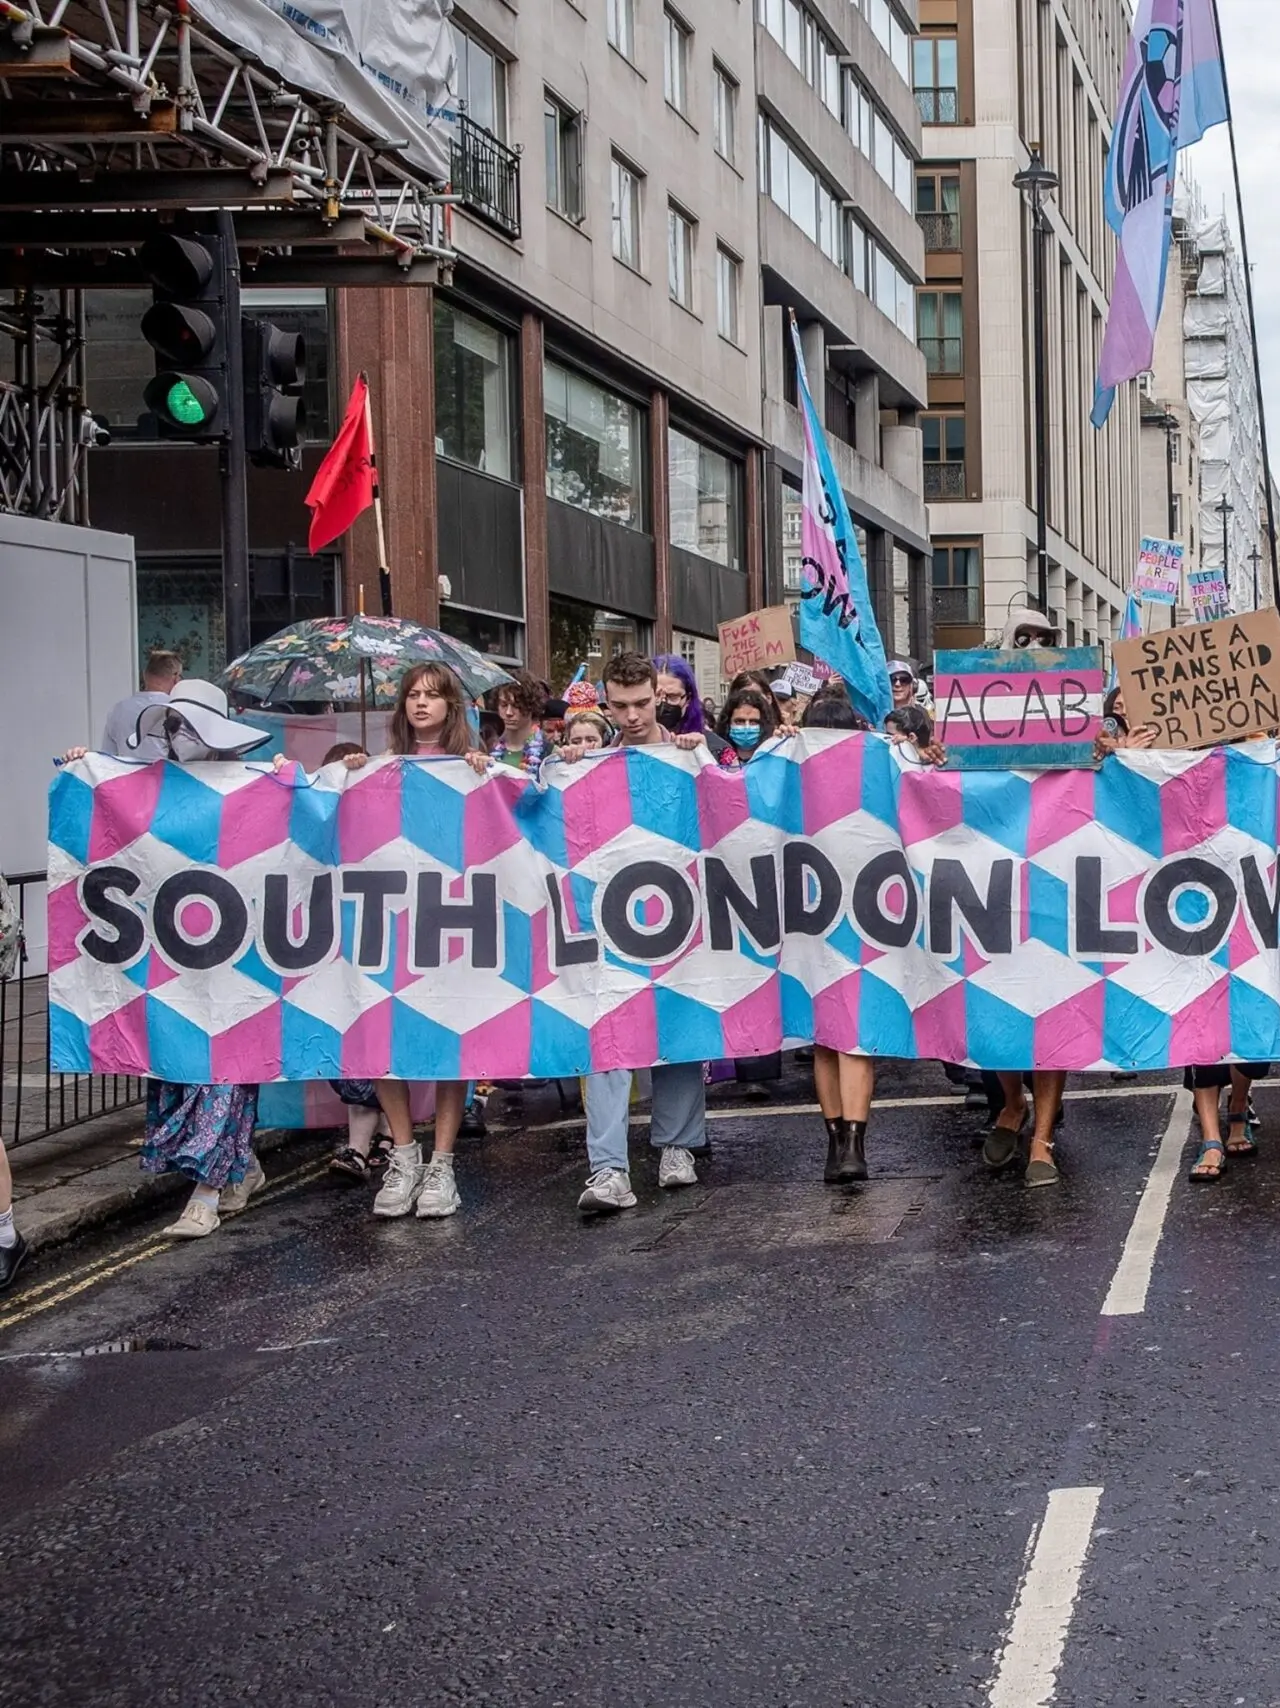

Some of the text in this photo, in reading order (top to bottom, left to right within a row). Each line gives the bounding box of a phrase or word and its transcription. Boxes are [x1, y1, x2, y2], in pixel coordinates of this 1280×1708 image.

[1143, 539, 1184, 557] TRANS
[1139, 551, 1179, 570] PEOPLE
[1145, 565, 1169, 580] ARE
[1196, 571, 1215, 584] LET
[1192, 581, 1224, 596] TRANS
[1192, 593, 1225, 607] PEOPLE
[732, 636, 757, 652] THE
[1141, 623, 1249, 664] SAVE A
[1131, 643, 1272, 691] TRANS KID
[1150, 673, 1271, 717] SMASH A
[940, 678, 1091, 742] ACAB
[81, 865, 498, 971] SOUTH
[546, 840, 1014, 967] LONDON
